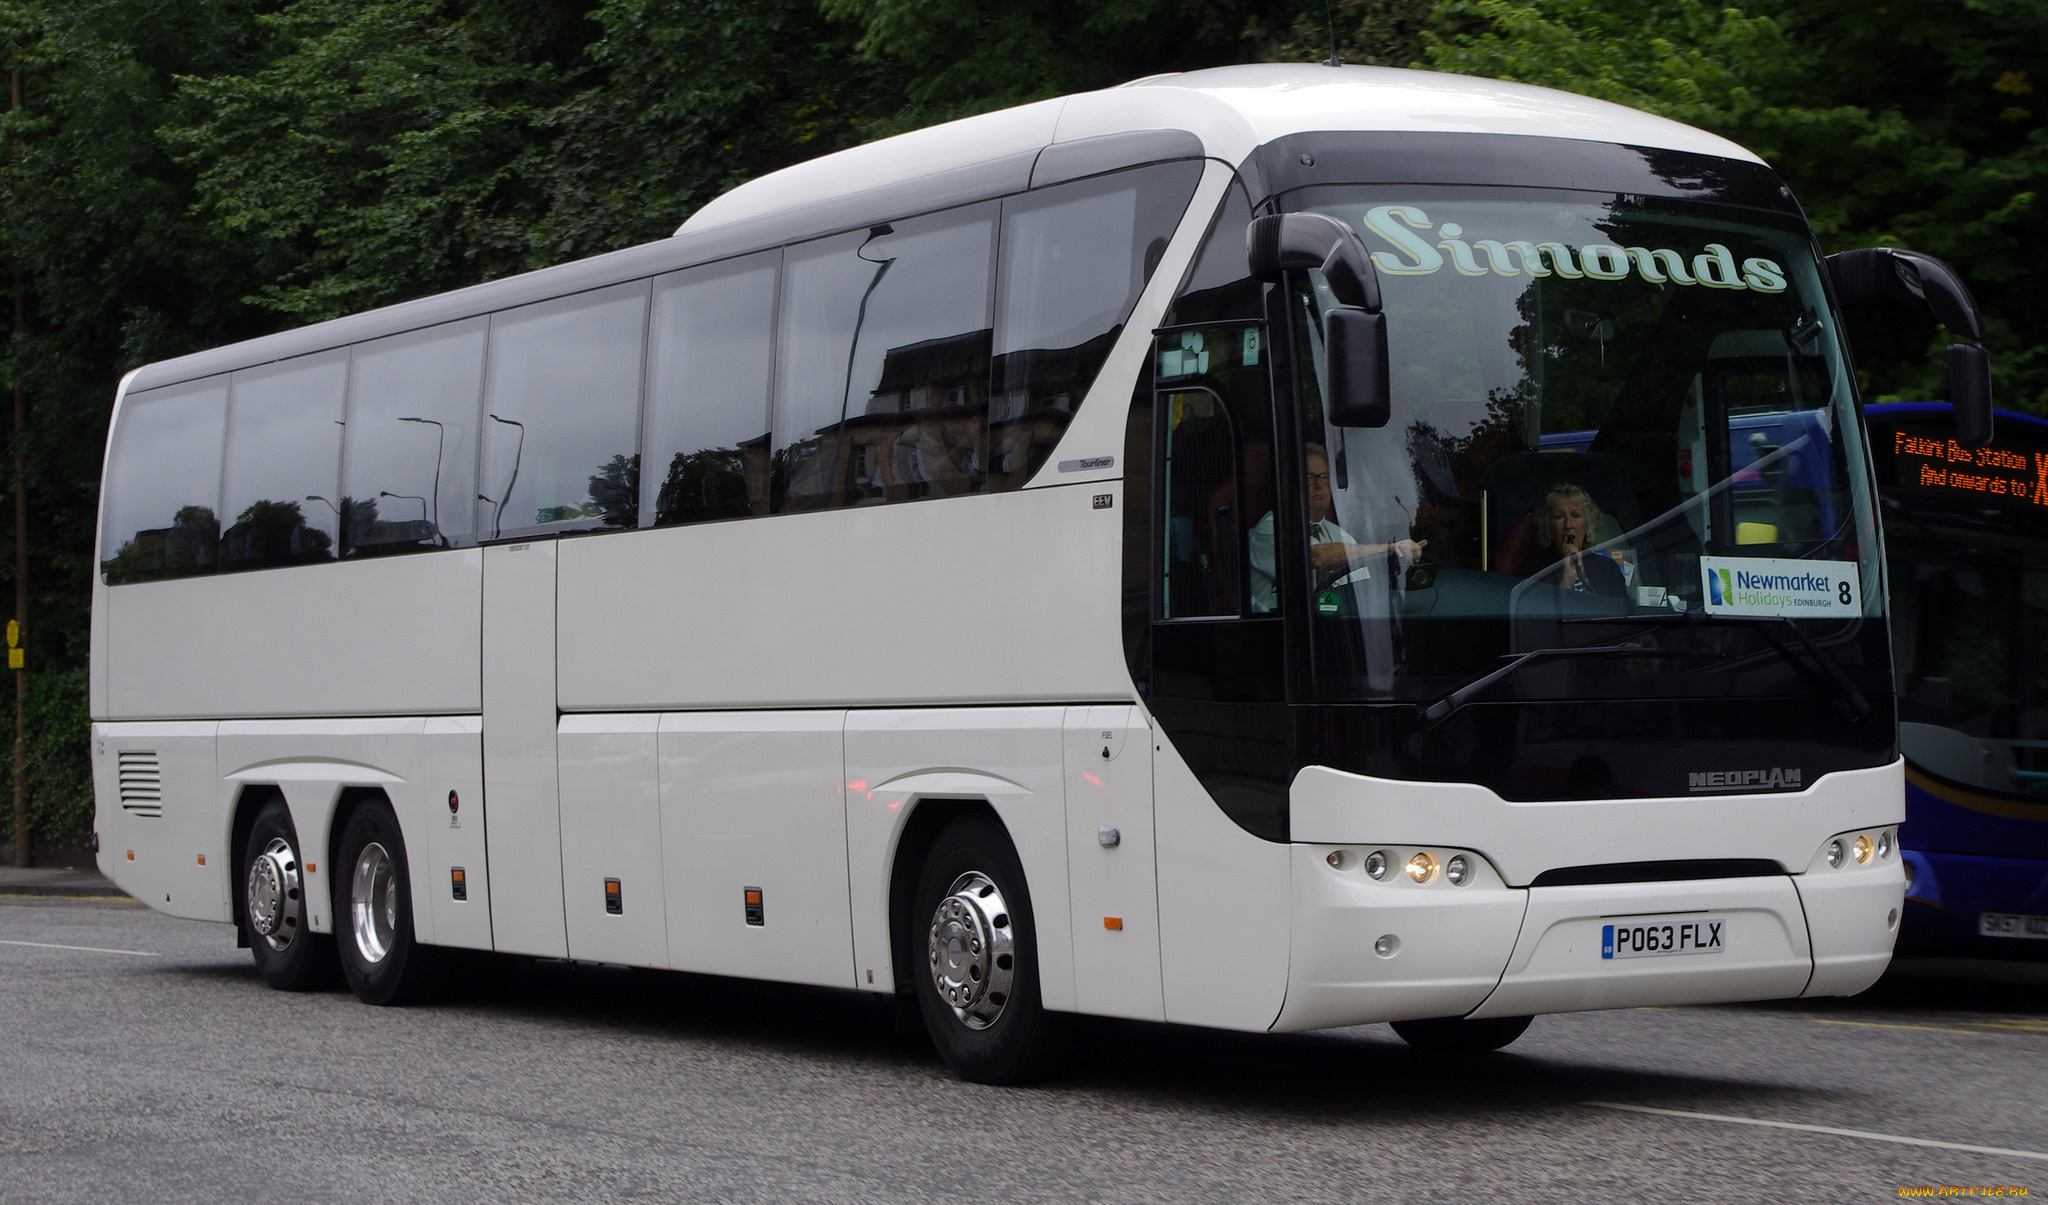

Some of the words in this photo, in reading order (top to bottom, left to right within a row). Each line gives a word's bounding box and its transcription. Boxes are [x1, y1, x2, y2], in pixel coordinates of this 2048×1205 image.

[1364, 206, 1788, 293] Simonds
[1895, 431, 1945, 458] Falkirk
[1947, 439, 1973, 462] Bus
[1976, 447, 2026, 470] Station
[1920, 463, 1946, 486] And
[1950, 473, 2007, 494] onwards
[1094, 495, 1112, 506] EEV
[1737, 571, 1831, 592] Newmarket
[1838, 581, 1852, 605] 8
[1739, 592, 1792, 608] Holidays
[1689, 767, 1801, 792] NEOPLAN
[1617, 926, 1674, 952] PO63
[1681, 922, 1721, 949] FLX
